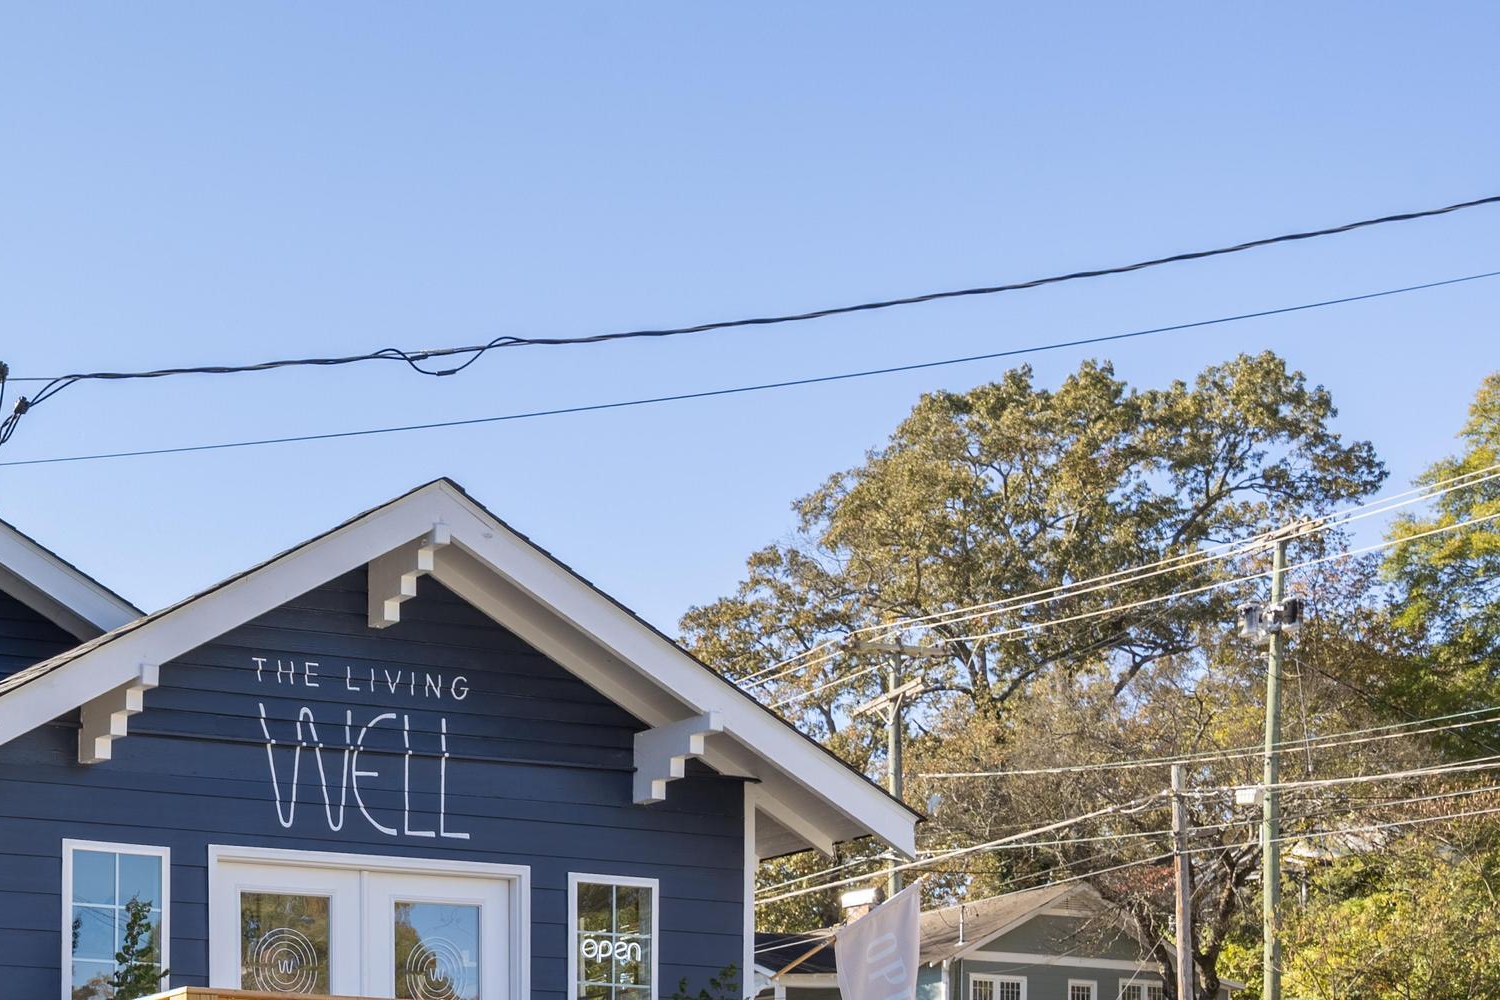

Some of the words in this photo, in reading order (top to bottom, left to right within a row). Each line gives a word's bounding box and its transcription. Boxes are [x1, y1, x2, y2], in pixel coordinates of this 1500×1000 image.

[252, 658, 319, 688] THE
[346, 666, 470, 701] LIVING
[258, 702, 471, 840] WELL
